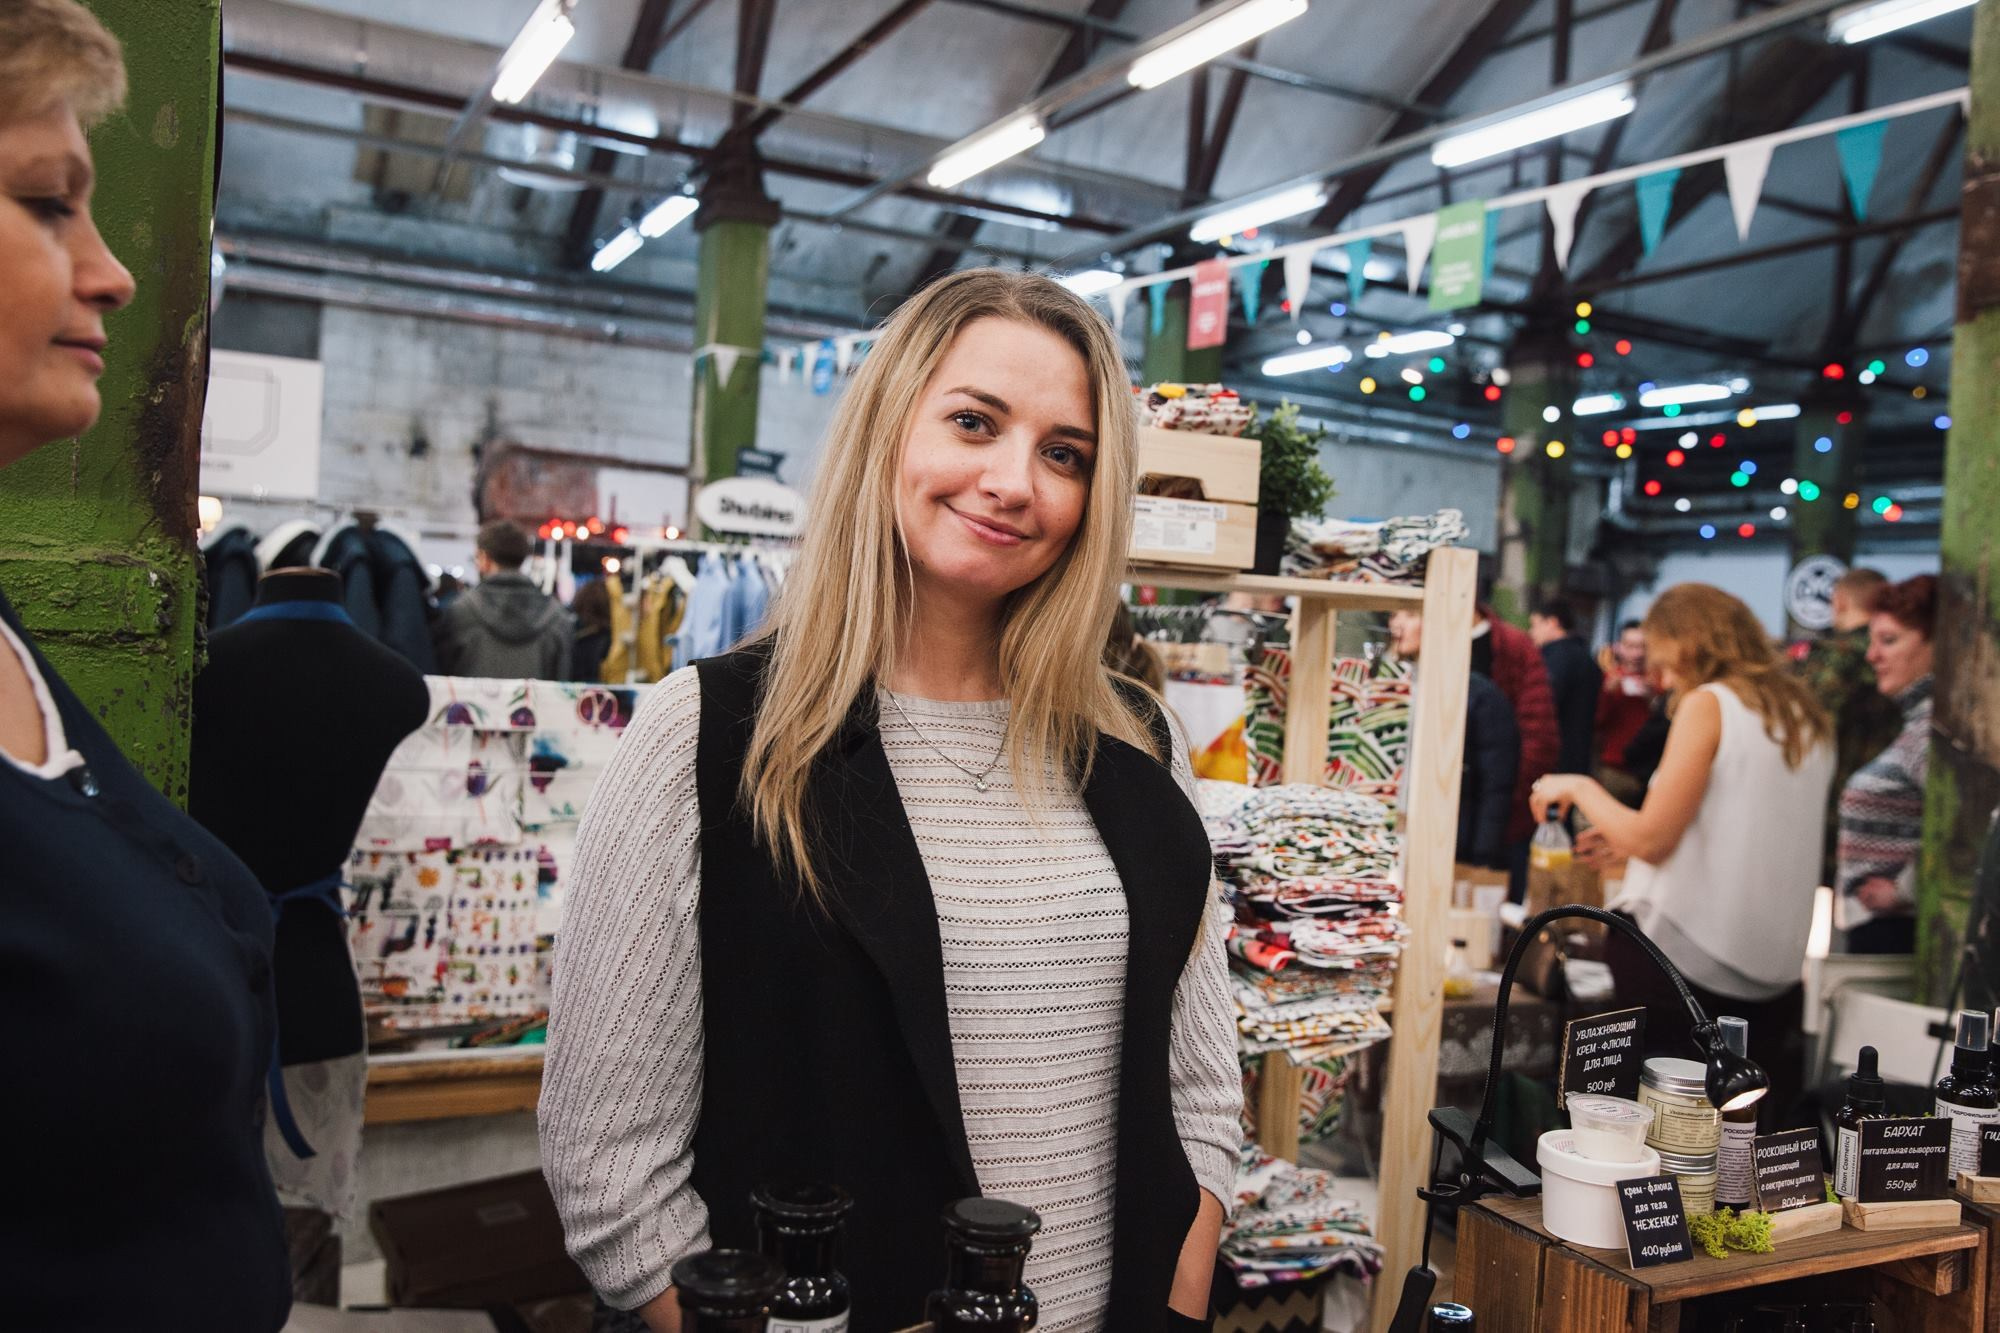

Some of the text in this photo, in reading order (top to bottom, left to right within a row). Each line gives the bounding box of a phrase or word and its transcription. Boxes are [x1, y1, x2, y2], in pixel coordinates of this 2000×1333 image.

[1576, 1018, 1636, 1041] УВЛАЖНЯЮЩИЙ
[1576, 1043, 1596, 1056] КРЕМ
[1601, 1036, 1631, 1050] ФЛЮИД
[1583, 1054, 1622, 1072] ДЛЯ ЛИЦА
[1587, 1078, 1615, 1092] 500 руб
[1884, 1126, 1925, 1137] БАРХАТ
[1757, 1139, 1817, 1159] РОСКОШНЫЙ КРЕМ
[1863, 1146, 1946, 1156] питательная сыворотка
[1759, 1160, 1799, 1178] увлажняющий
[1886, 1162, 1900, 1170] для
[1795, 1175, 1814, 1187] улитки
[1886, 1180, 1917, 1191] 550 руб
[1624, 1186, 1643, 1198] крем
[1648, 1182, 1673, 1195] флюид
[1635, 1202, 1668, 1214] для тела
[1782, 1195, 1806, 1208] 800 руб
[1633, 1214, 1679, 1231] "НЕЖЕНКА"
[1641, 1243, 1682, 1257] 400 рублей
